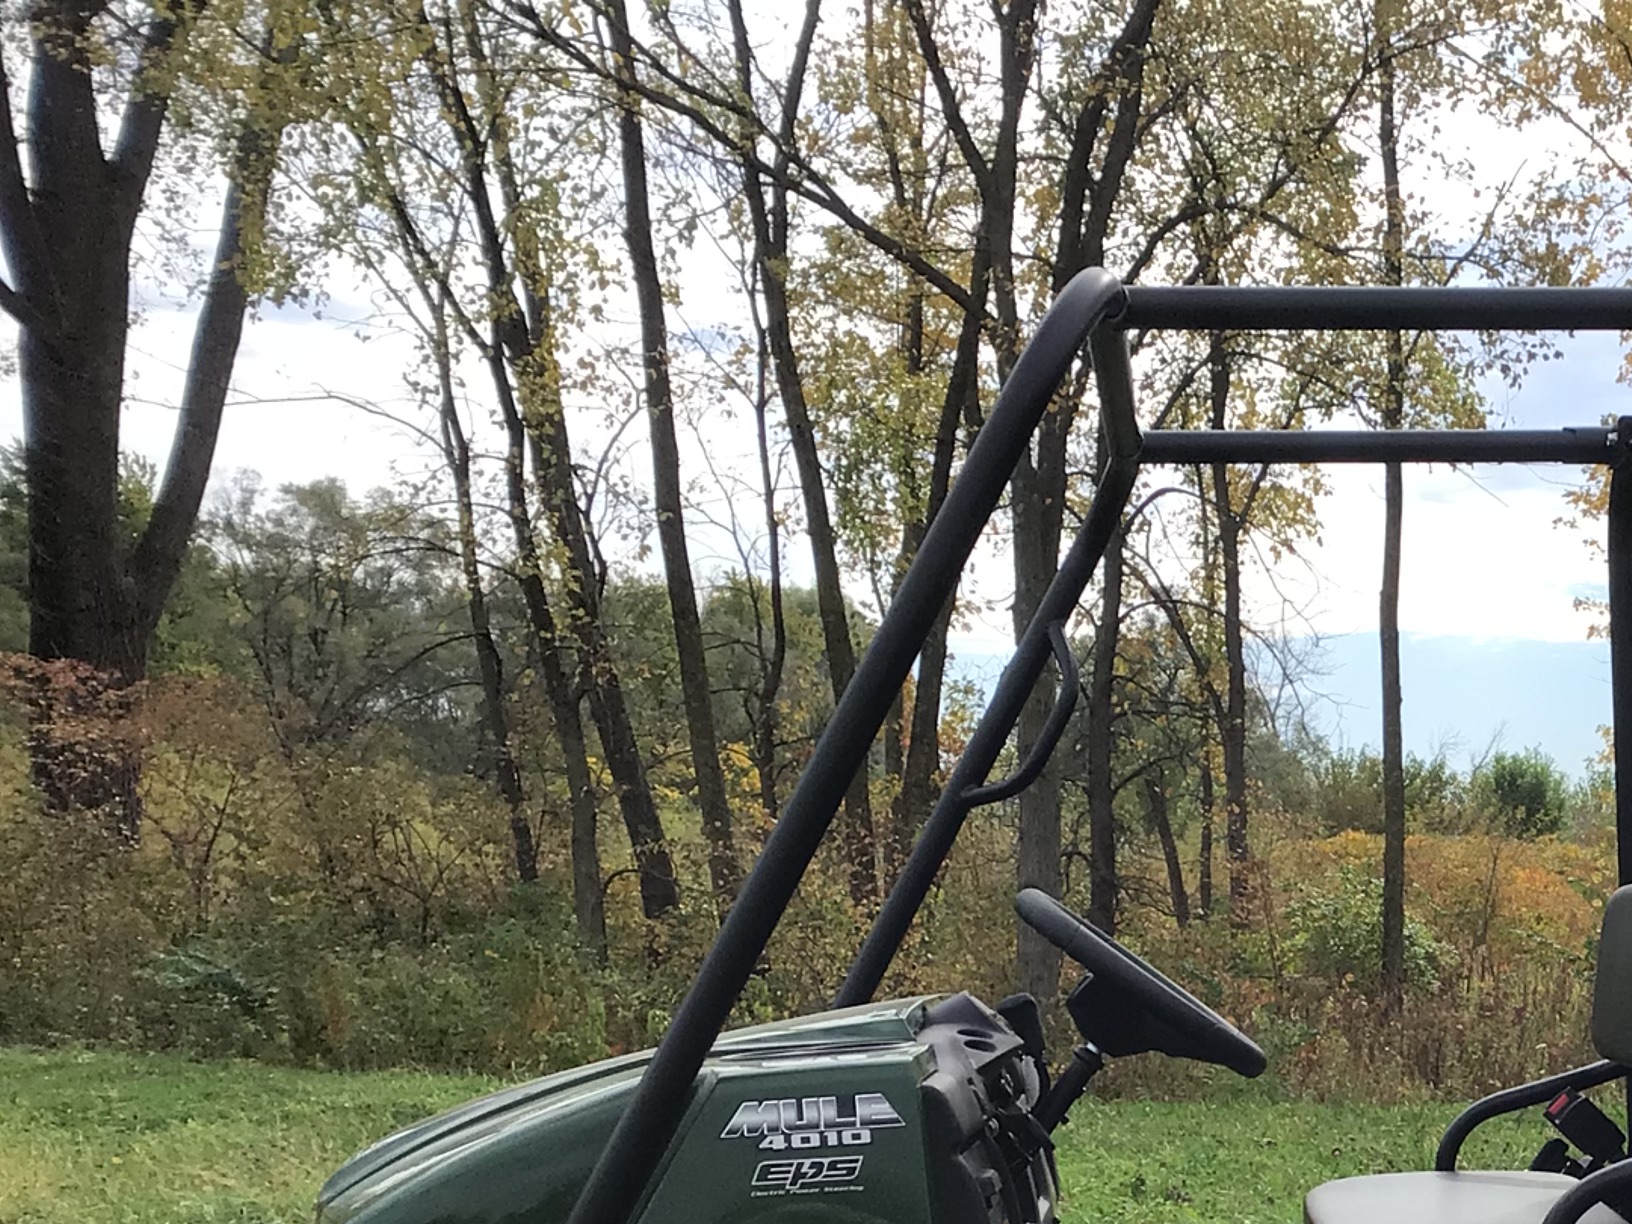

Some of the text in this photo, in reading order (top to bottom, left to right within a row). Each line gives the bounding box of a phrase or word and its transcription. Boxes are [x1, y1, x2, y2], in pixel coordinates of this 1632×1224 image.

[720, 1093, 906, 1138] MULE
[758, 1129, 872, 1150] 4010
[751, 1155, 863, 1189] EPS
